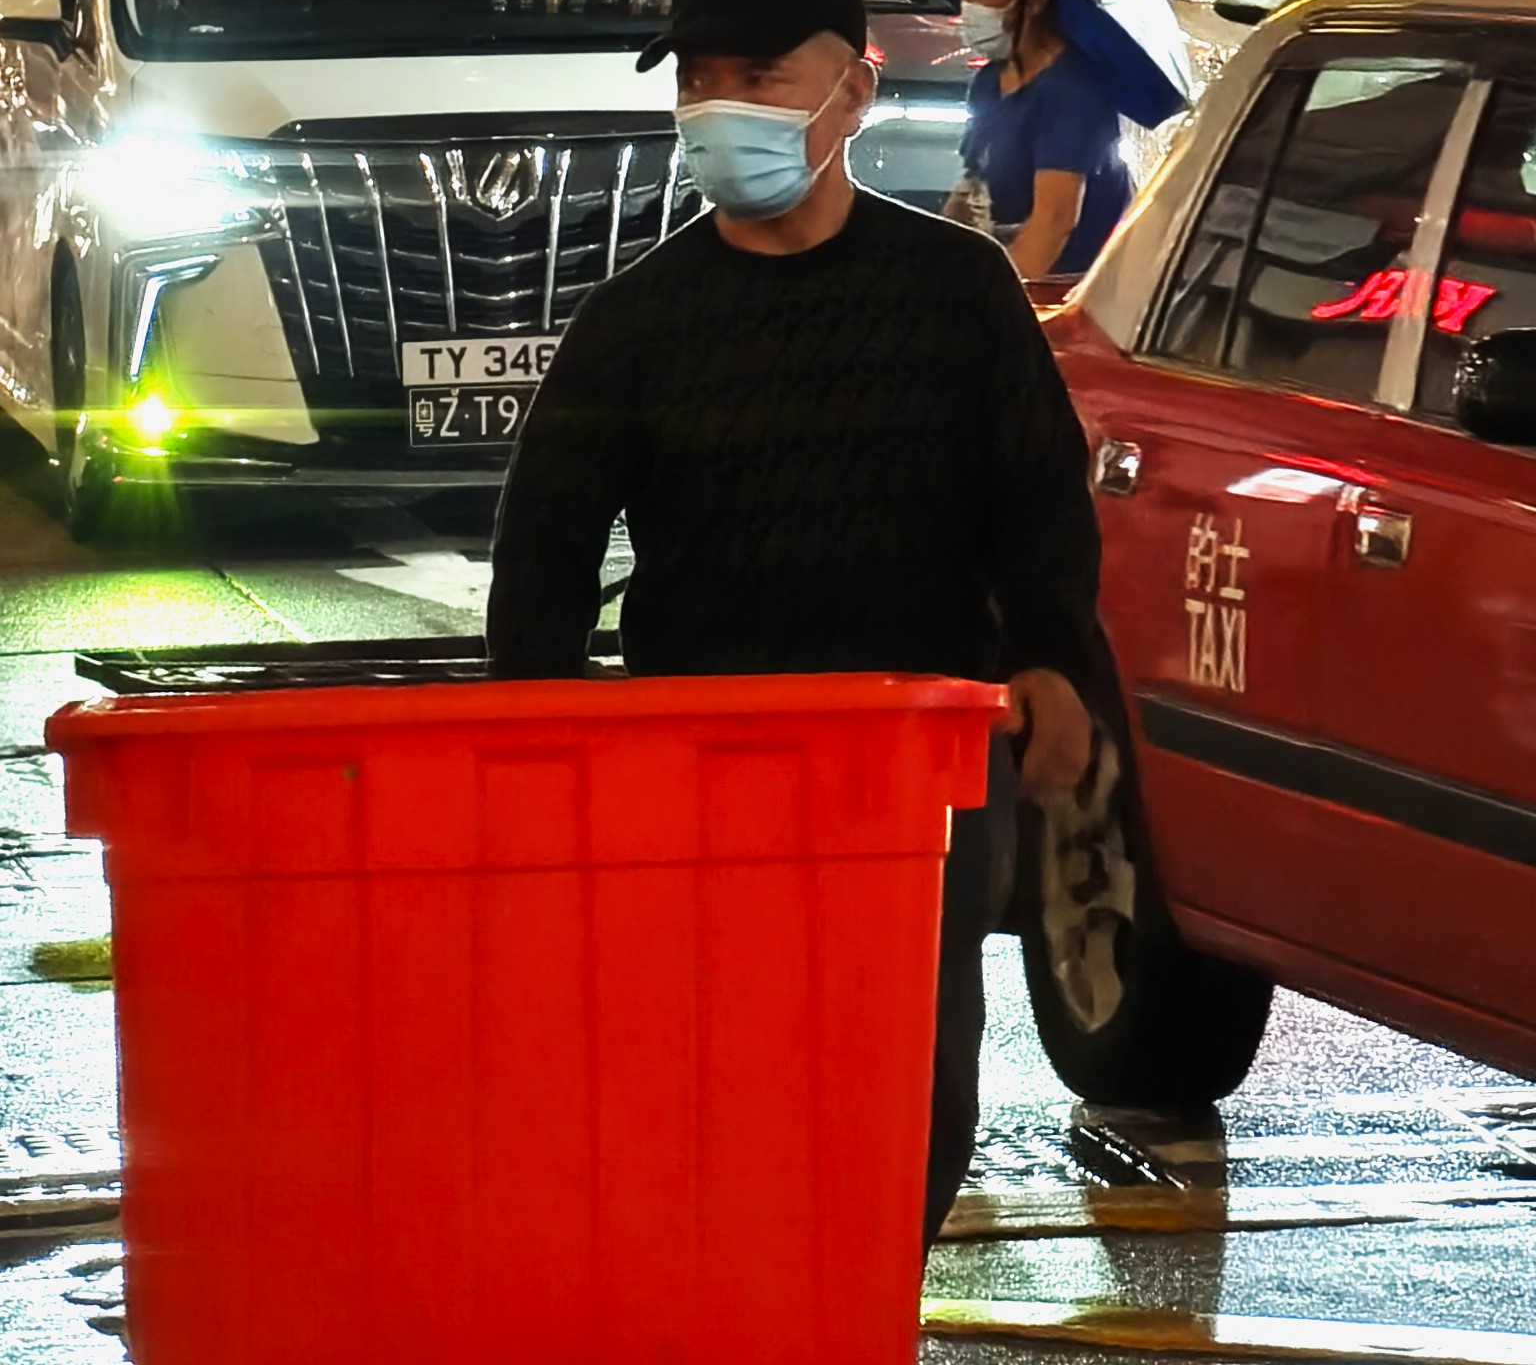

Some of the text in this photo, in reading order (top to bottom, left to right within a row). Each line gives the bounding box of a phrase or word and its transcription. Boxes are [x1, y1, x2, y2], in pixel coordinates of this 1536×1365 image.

[419, 346, 468, 380] TY
[1185, 512, 1250, 600] 的士
[1184, 597, 1247, 694] TAXI
